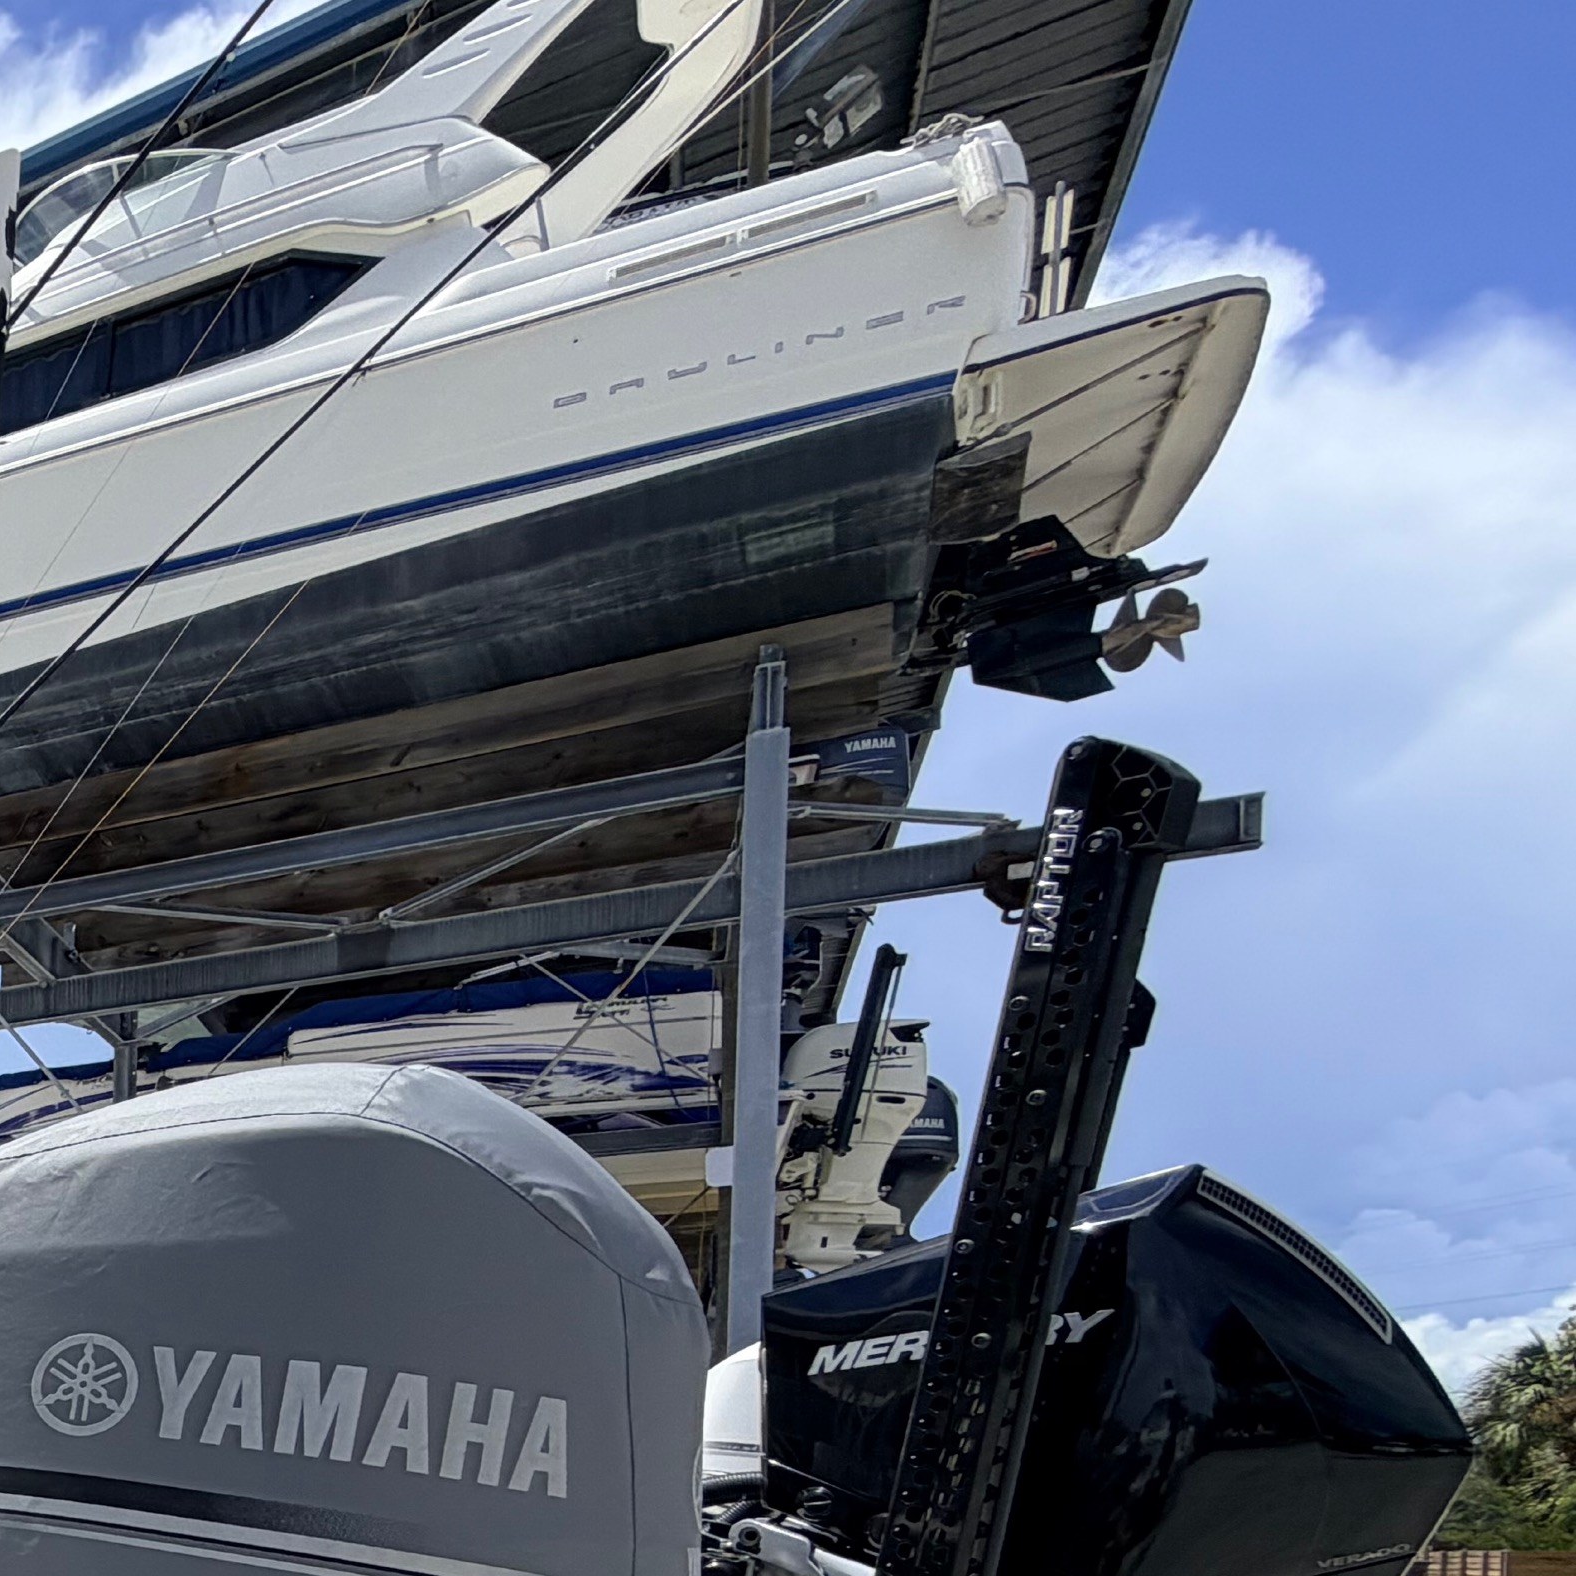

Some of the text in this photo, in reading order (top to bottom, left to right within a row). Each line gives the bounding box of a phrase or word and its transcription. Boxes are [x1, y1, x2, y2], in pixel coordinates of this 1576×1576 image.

[845, 737, 896, 753] YAMAHA
[1025, 808, 1083, 951] RAPTOR
[807, 1309, 1116, 1376] MERRY
[153, 1346, 568, 1499] YAMAHA
[1317, 1543, 1411, 1568] VERADO
